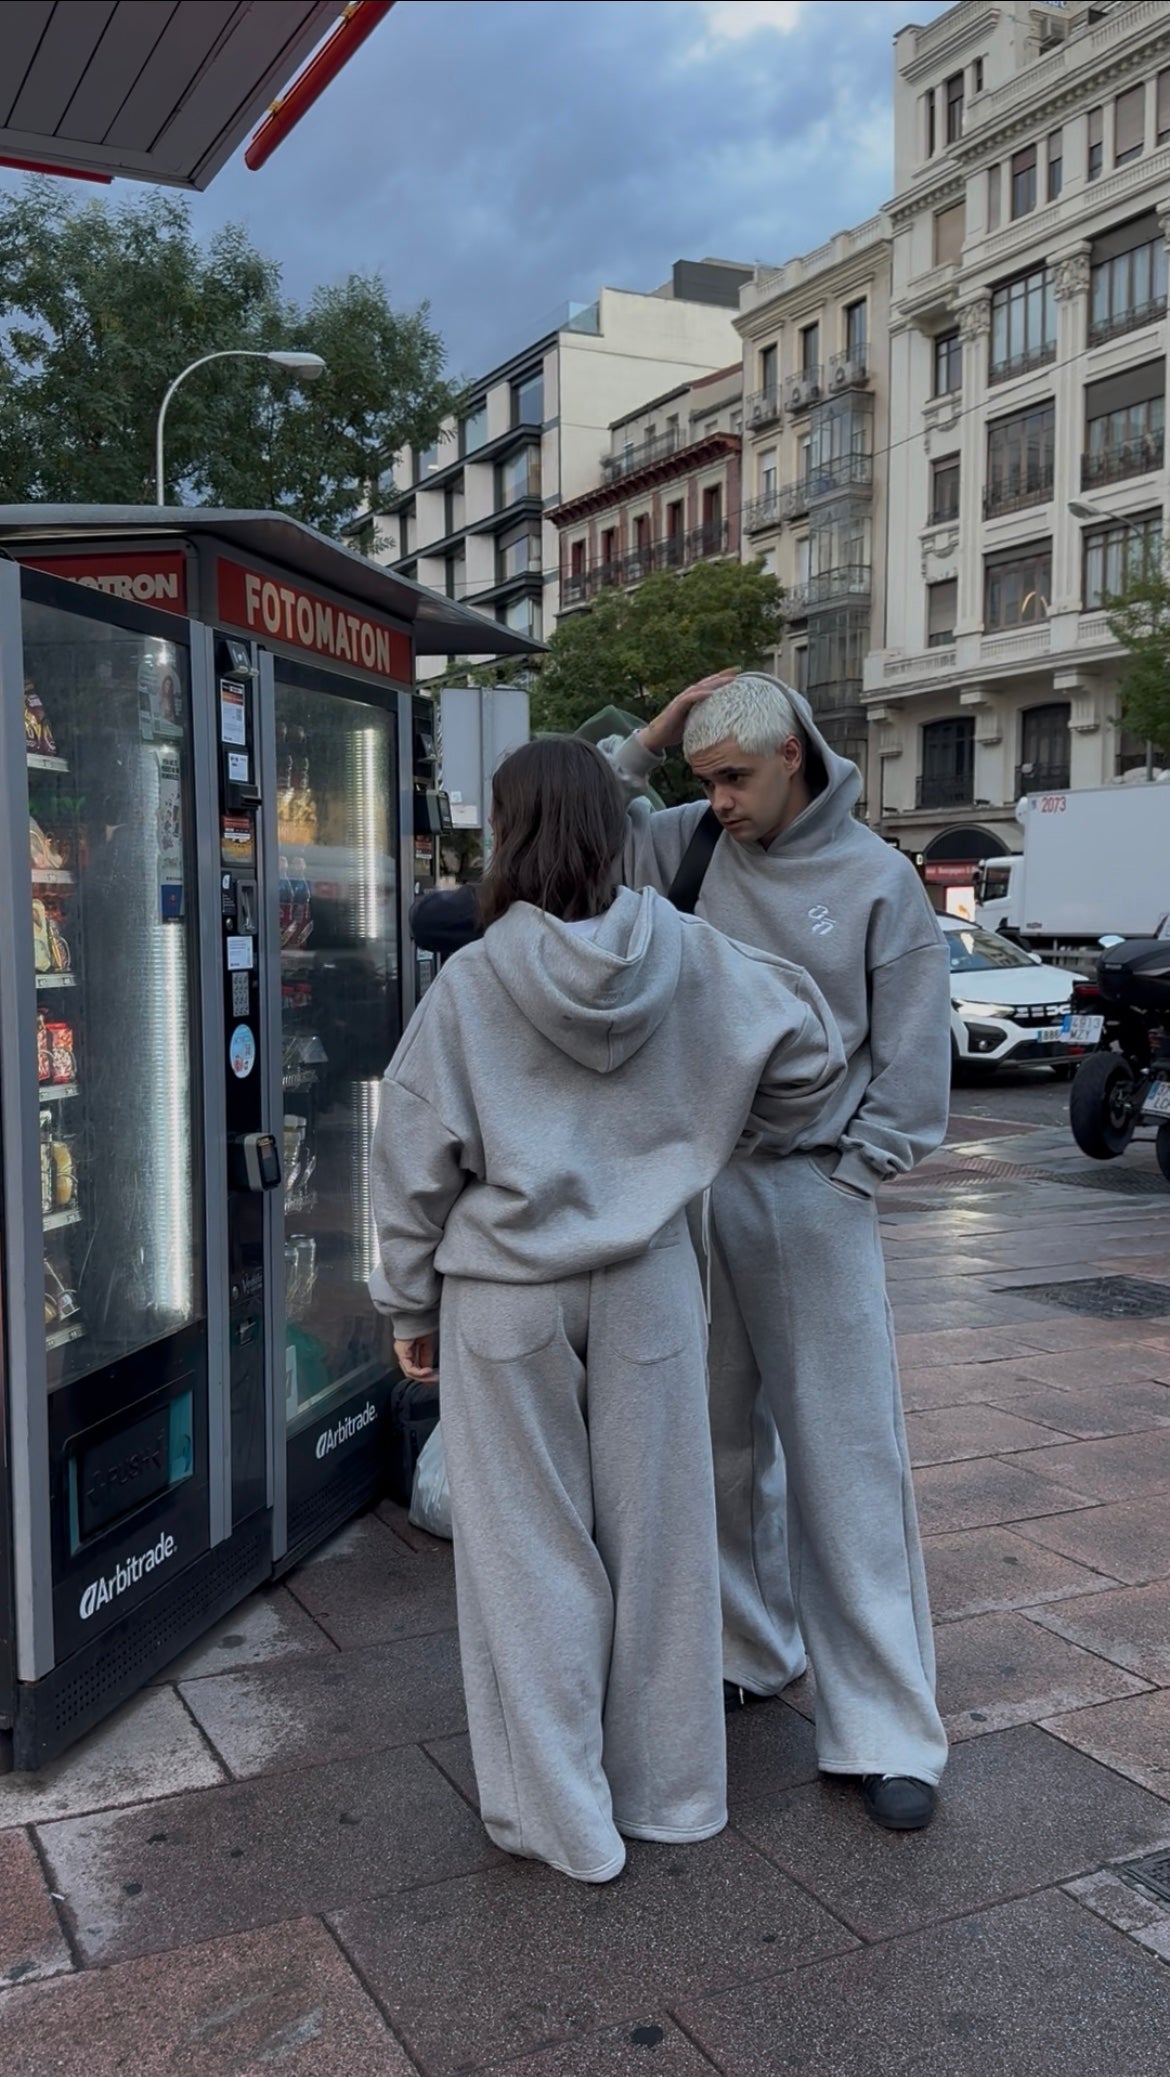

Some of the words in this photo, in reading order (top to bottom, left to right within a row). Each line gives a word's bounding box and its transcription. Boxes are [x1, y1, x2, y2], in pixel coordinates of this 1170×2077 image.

[68, 573, 178, 600] TRON
[245, 573, 391, 674] FOTOMATON
[1041, 796, 1067, 814] 2073
[326, 1401, 377, 1454] Arbitrade
[95, 1531, 176, 1612] Arbitrade
